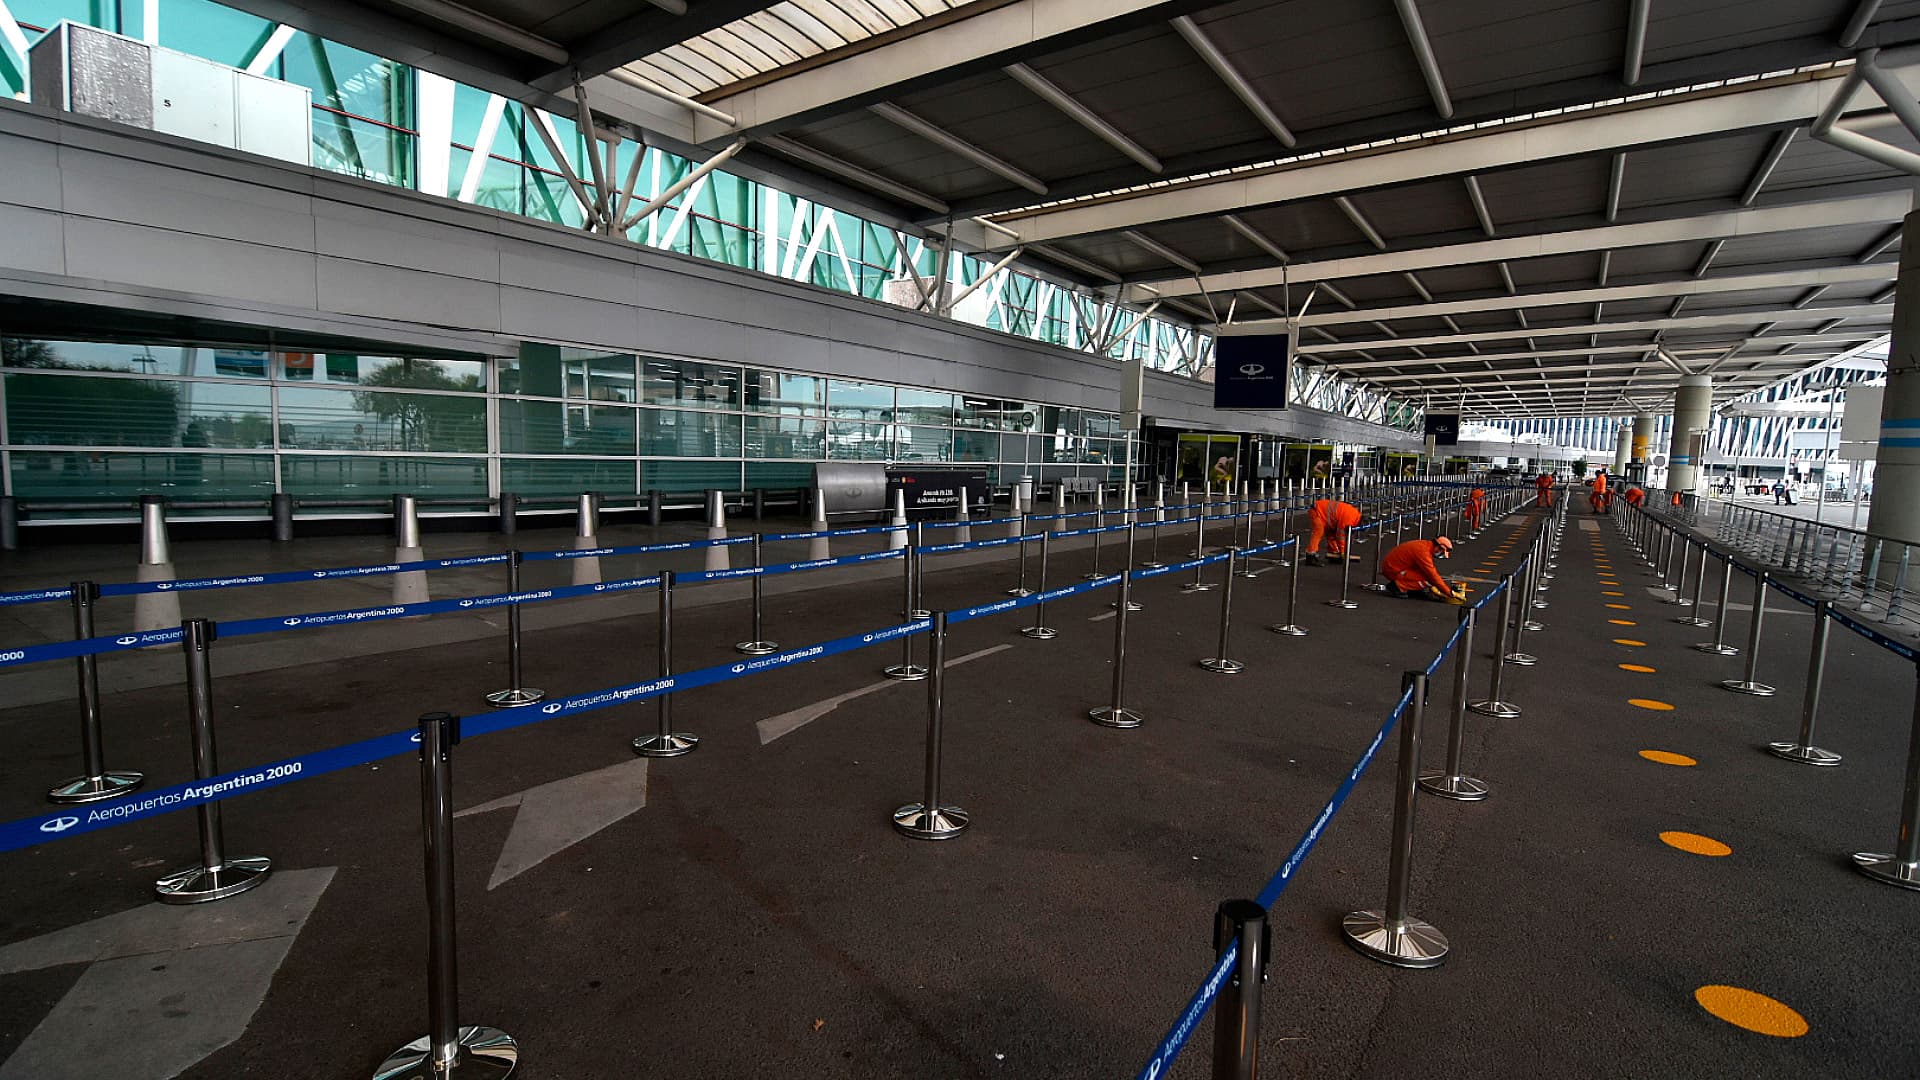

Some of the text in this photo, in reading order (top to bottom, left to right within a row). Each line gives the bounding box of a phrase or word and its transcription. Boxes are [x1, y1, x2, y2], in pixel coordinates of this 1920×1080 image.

[175, 580, 211, 588] Aeropuertos
[212, 577, 247, 585] Argentina
[304, 613, 346, 624] Aeropuertos
[346, 609, 386, 620] Argentina
[780, 650, 809, 663] Argentina
[809, 646, 823, 655] 2000
[565, 679, 674, 709] Aeropuertos Argentina 2000
[88, 762, 302, 824] Aeropuertos Argentina 2000
[1164, 995, 1204, 1062] Aeropuertos
